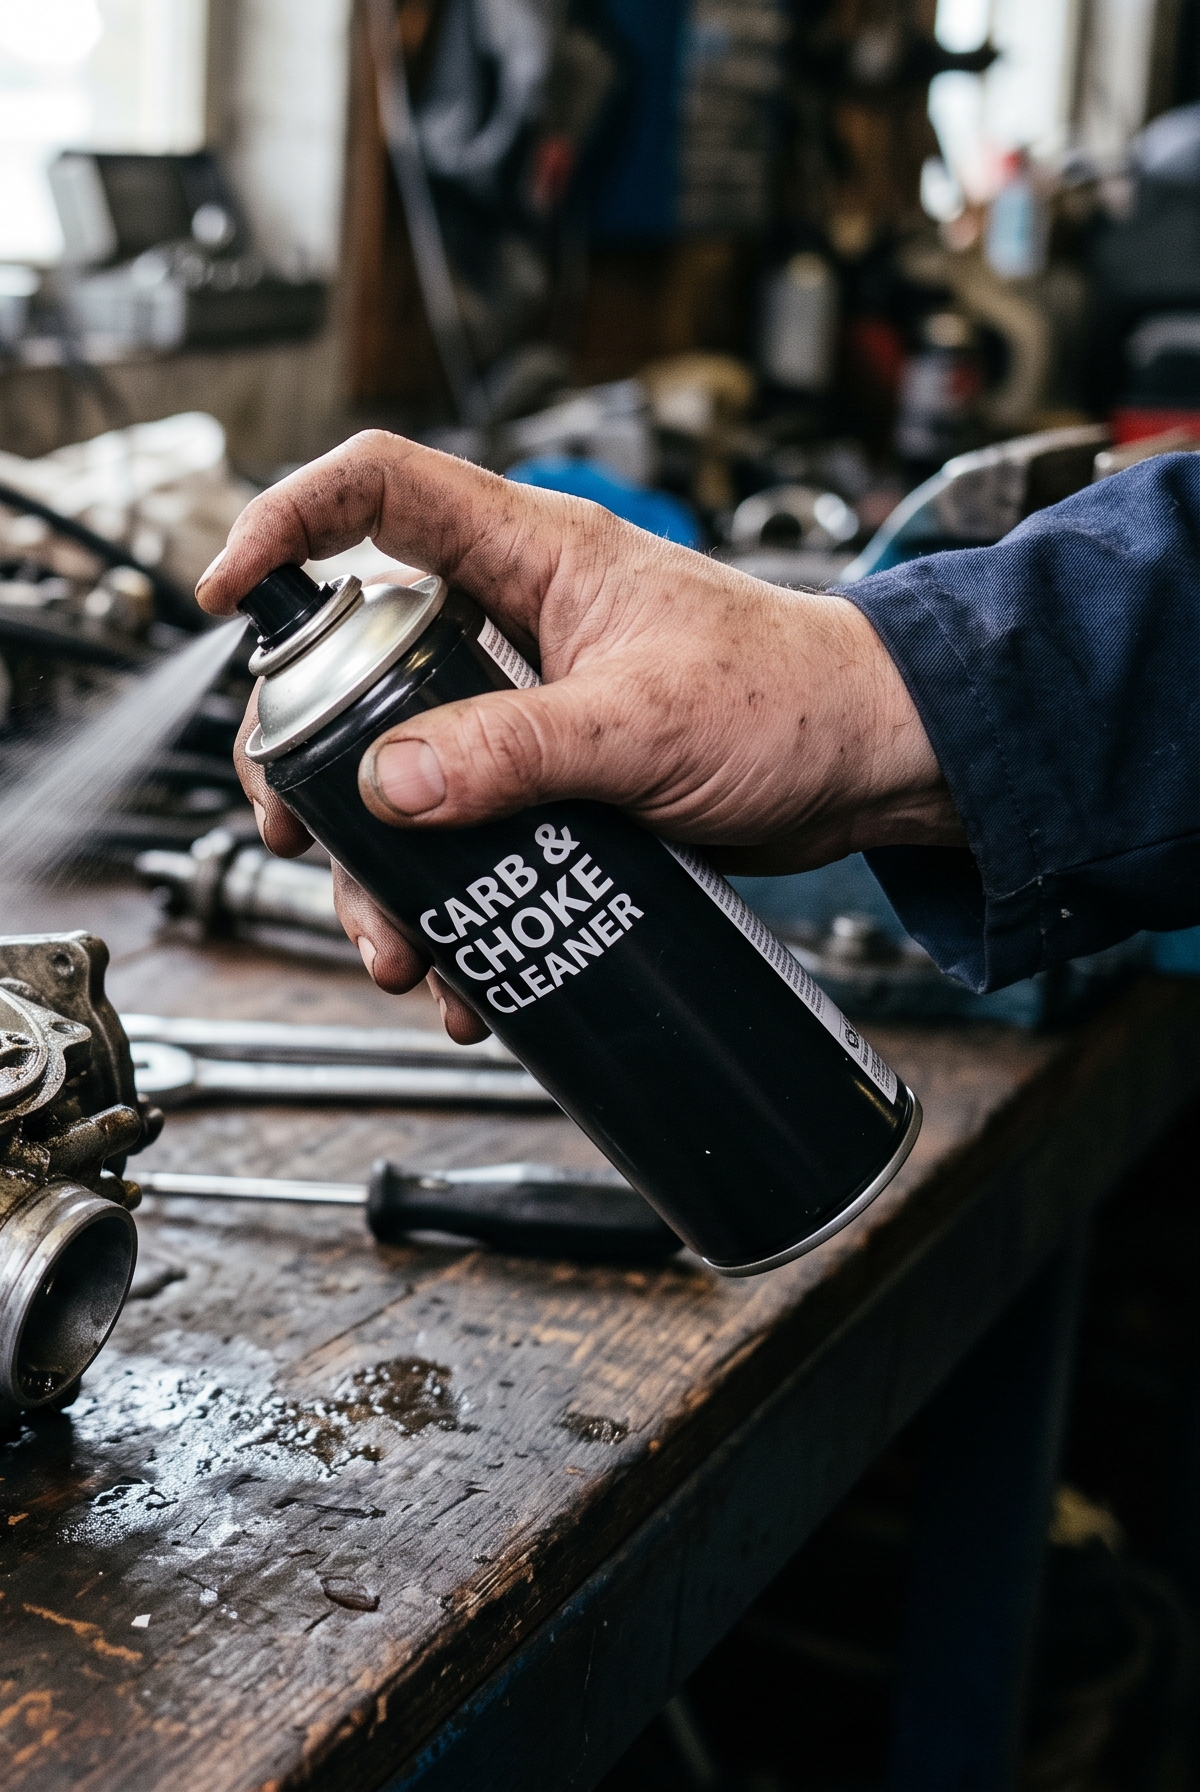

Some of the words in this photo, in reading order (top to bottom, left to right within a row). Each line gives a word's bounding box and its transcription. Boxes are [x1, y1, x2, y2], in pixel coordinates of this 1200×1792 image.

[420, 854, 539, 944] CARB
[534, 823, 581, 865] &
[455, 853, 615, 981] CHOKE
[486, 893, 645, 1014] CLEANER
